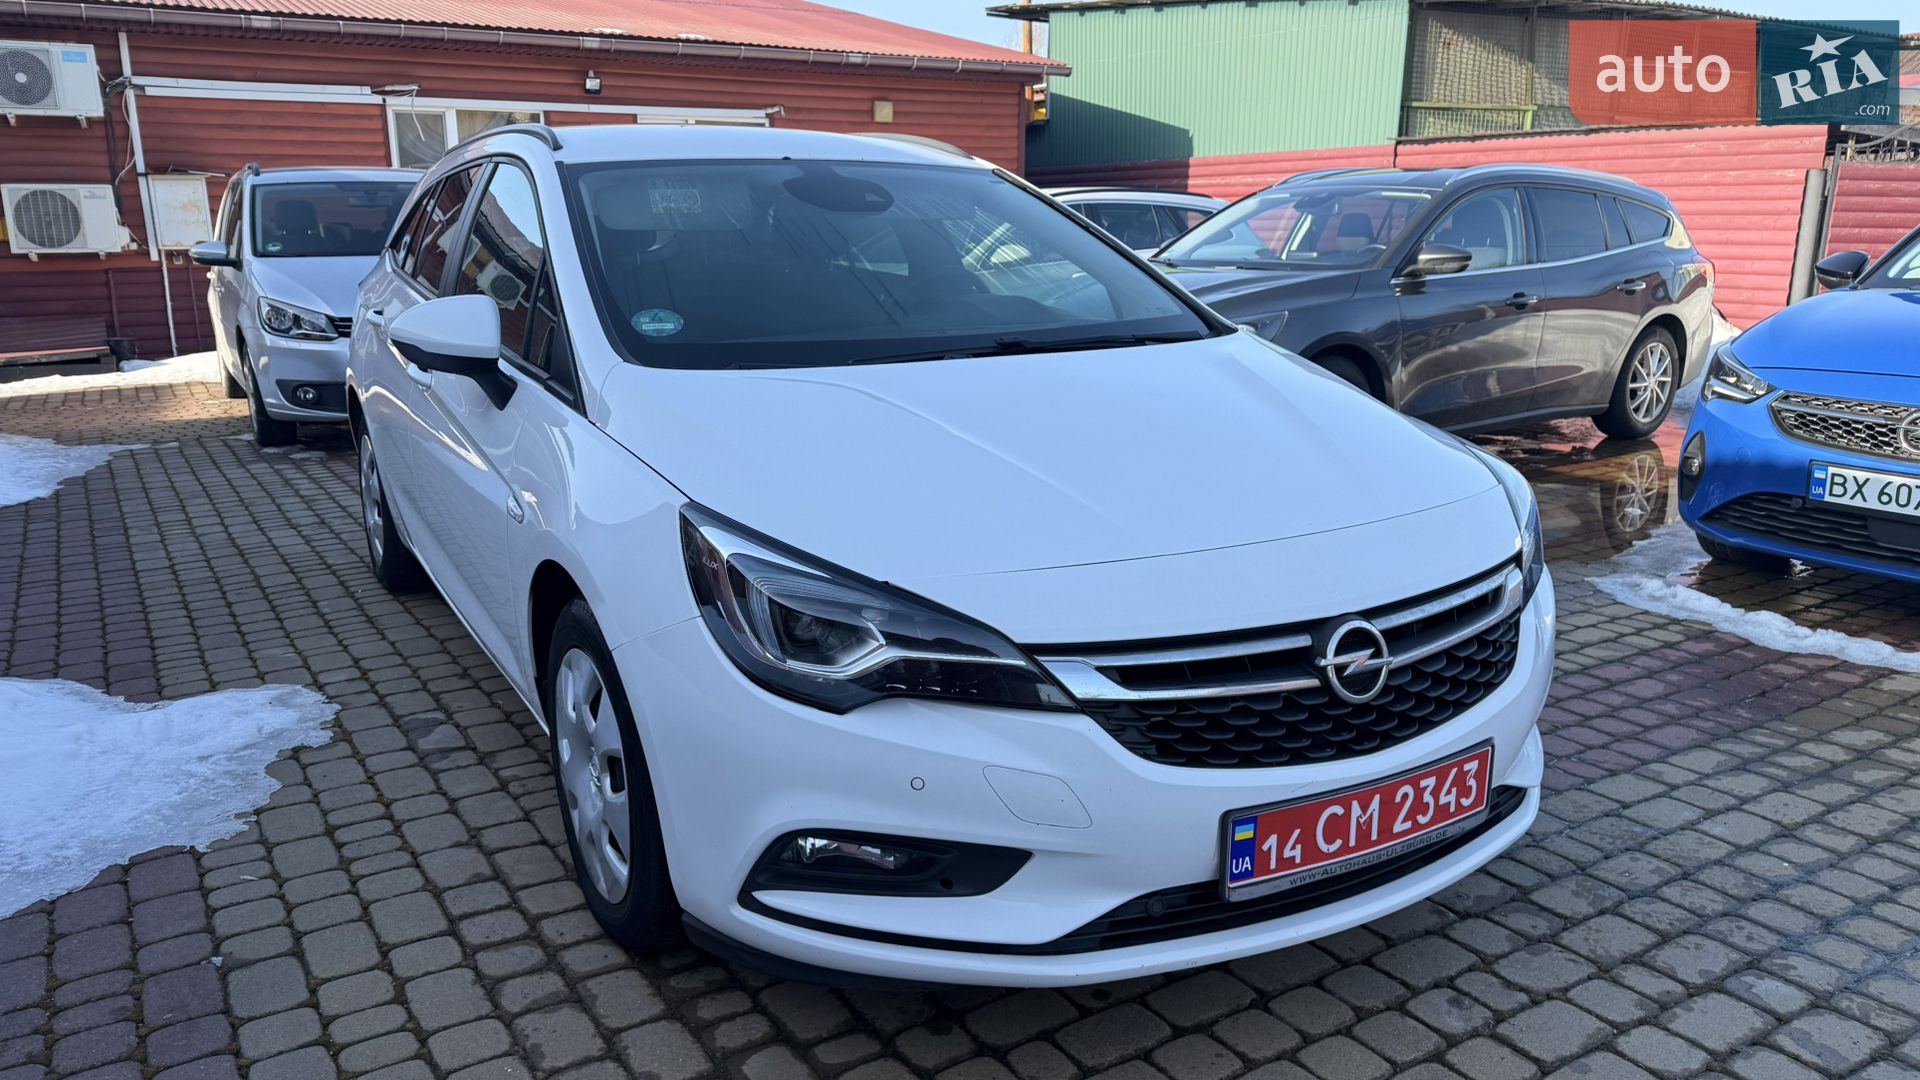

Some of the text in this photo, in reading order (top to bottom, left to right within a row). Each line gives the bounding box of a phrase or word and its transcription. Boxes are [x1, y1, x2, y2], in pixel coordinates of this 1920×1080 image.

[1811, 485, 1824, 496] UA
[1828, 472, 1871, 503] BX
[1261, 759, 1479, 870] 14 CM 2343
[1231, 855, 1252, 874] UA
